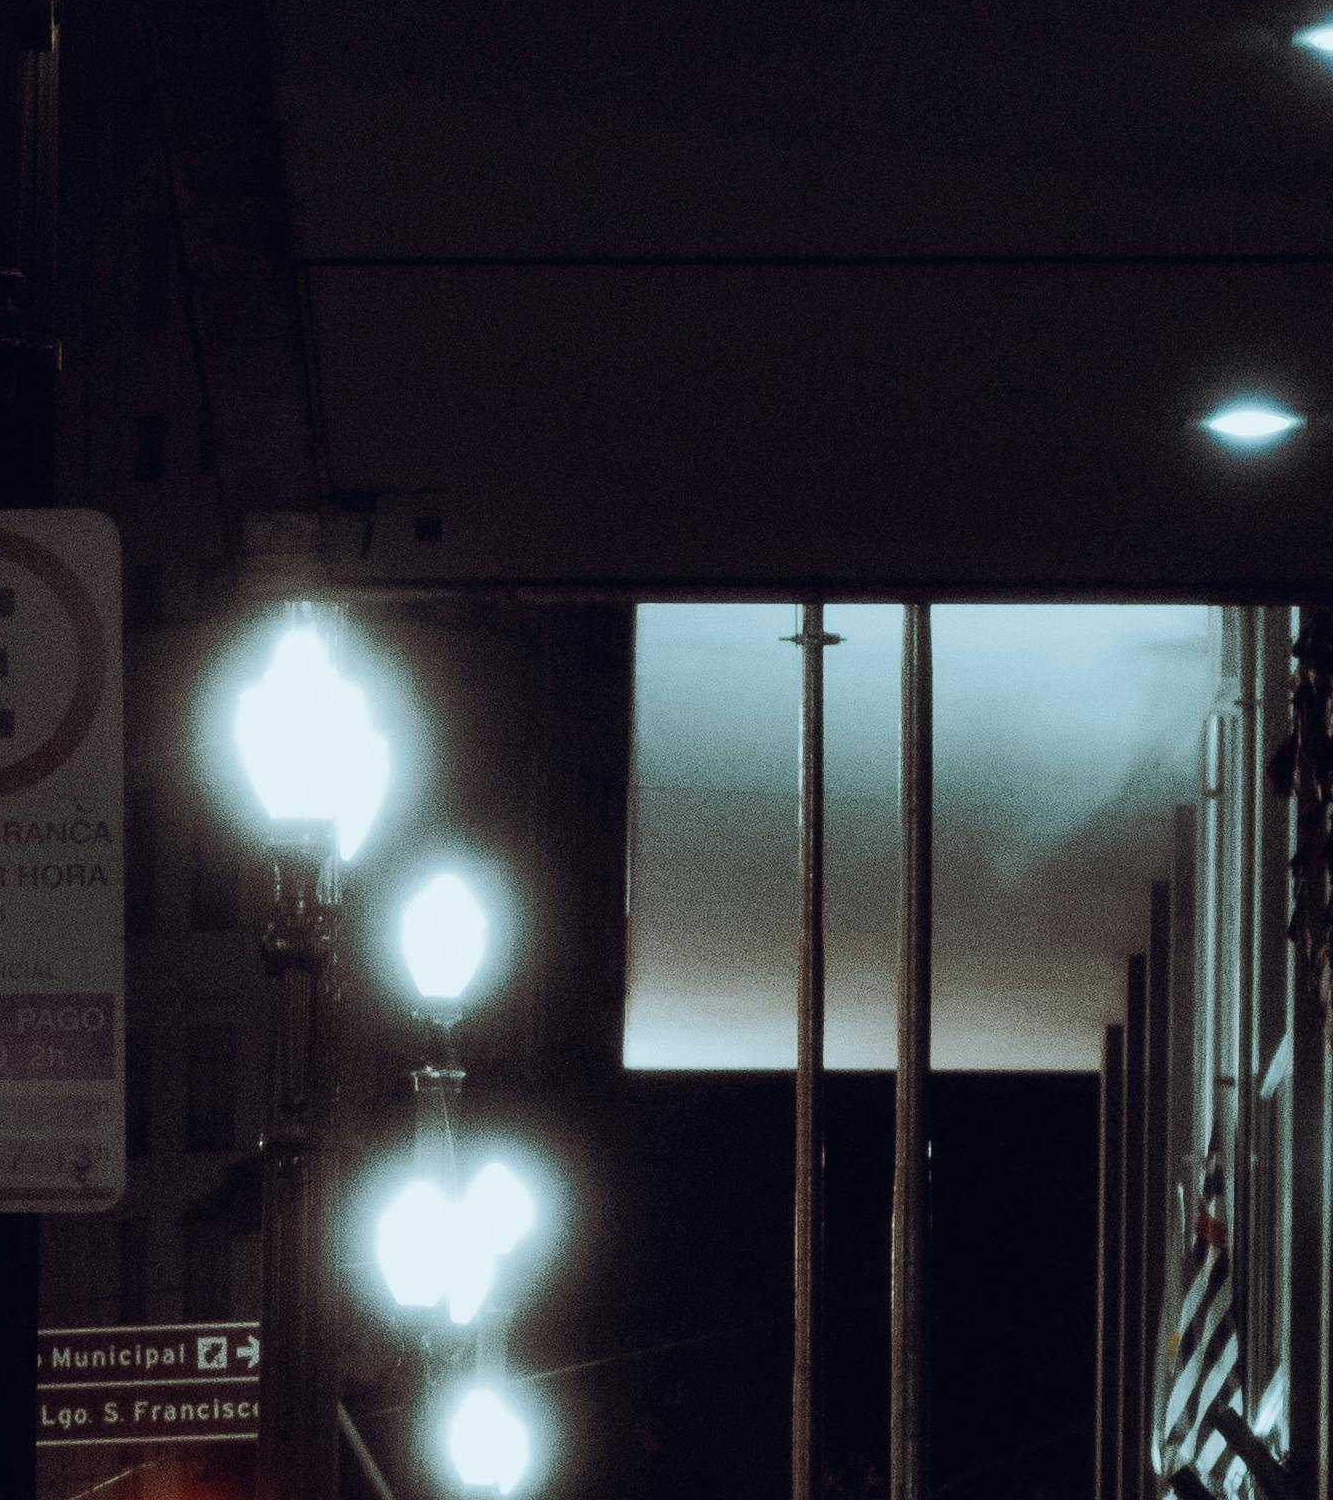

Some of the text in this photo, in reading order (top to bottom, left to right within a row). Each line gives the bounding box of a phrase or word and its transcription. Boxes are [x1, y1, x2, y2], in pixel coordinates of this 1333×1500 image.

[18, 863, 109, 889] HORA
[17, 1006, 107, 1032] PAGO
[31, 1043, 67, 1068] 2h
[51, 1342, 186, 1370] Municipal
[41, 1404, 93, 1430] Lgo.
[104, 1400, 125, 1424] S.
